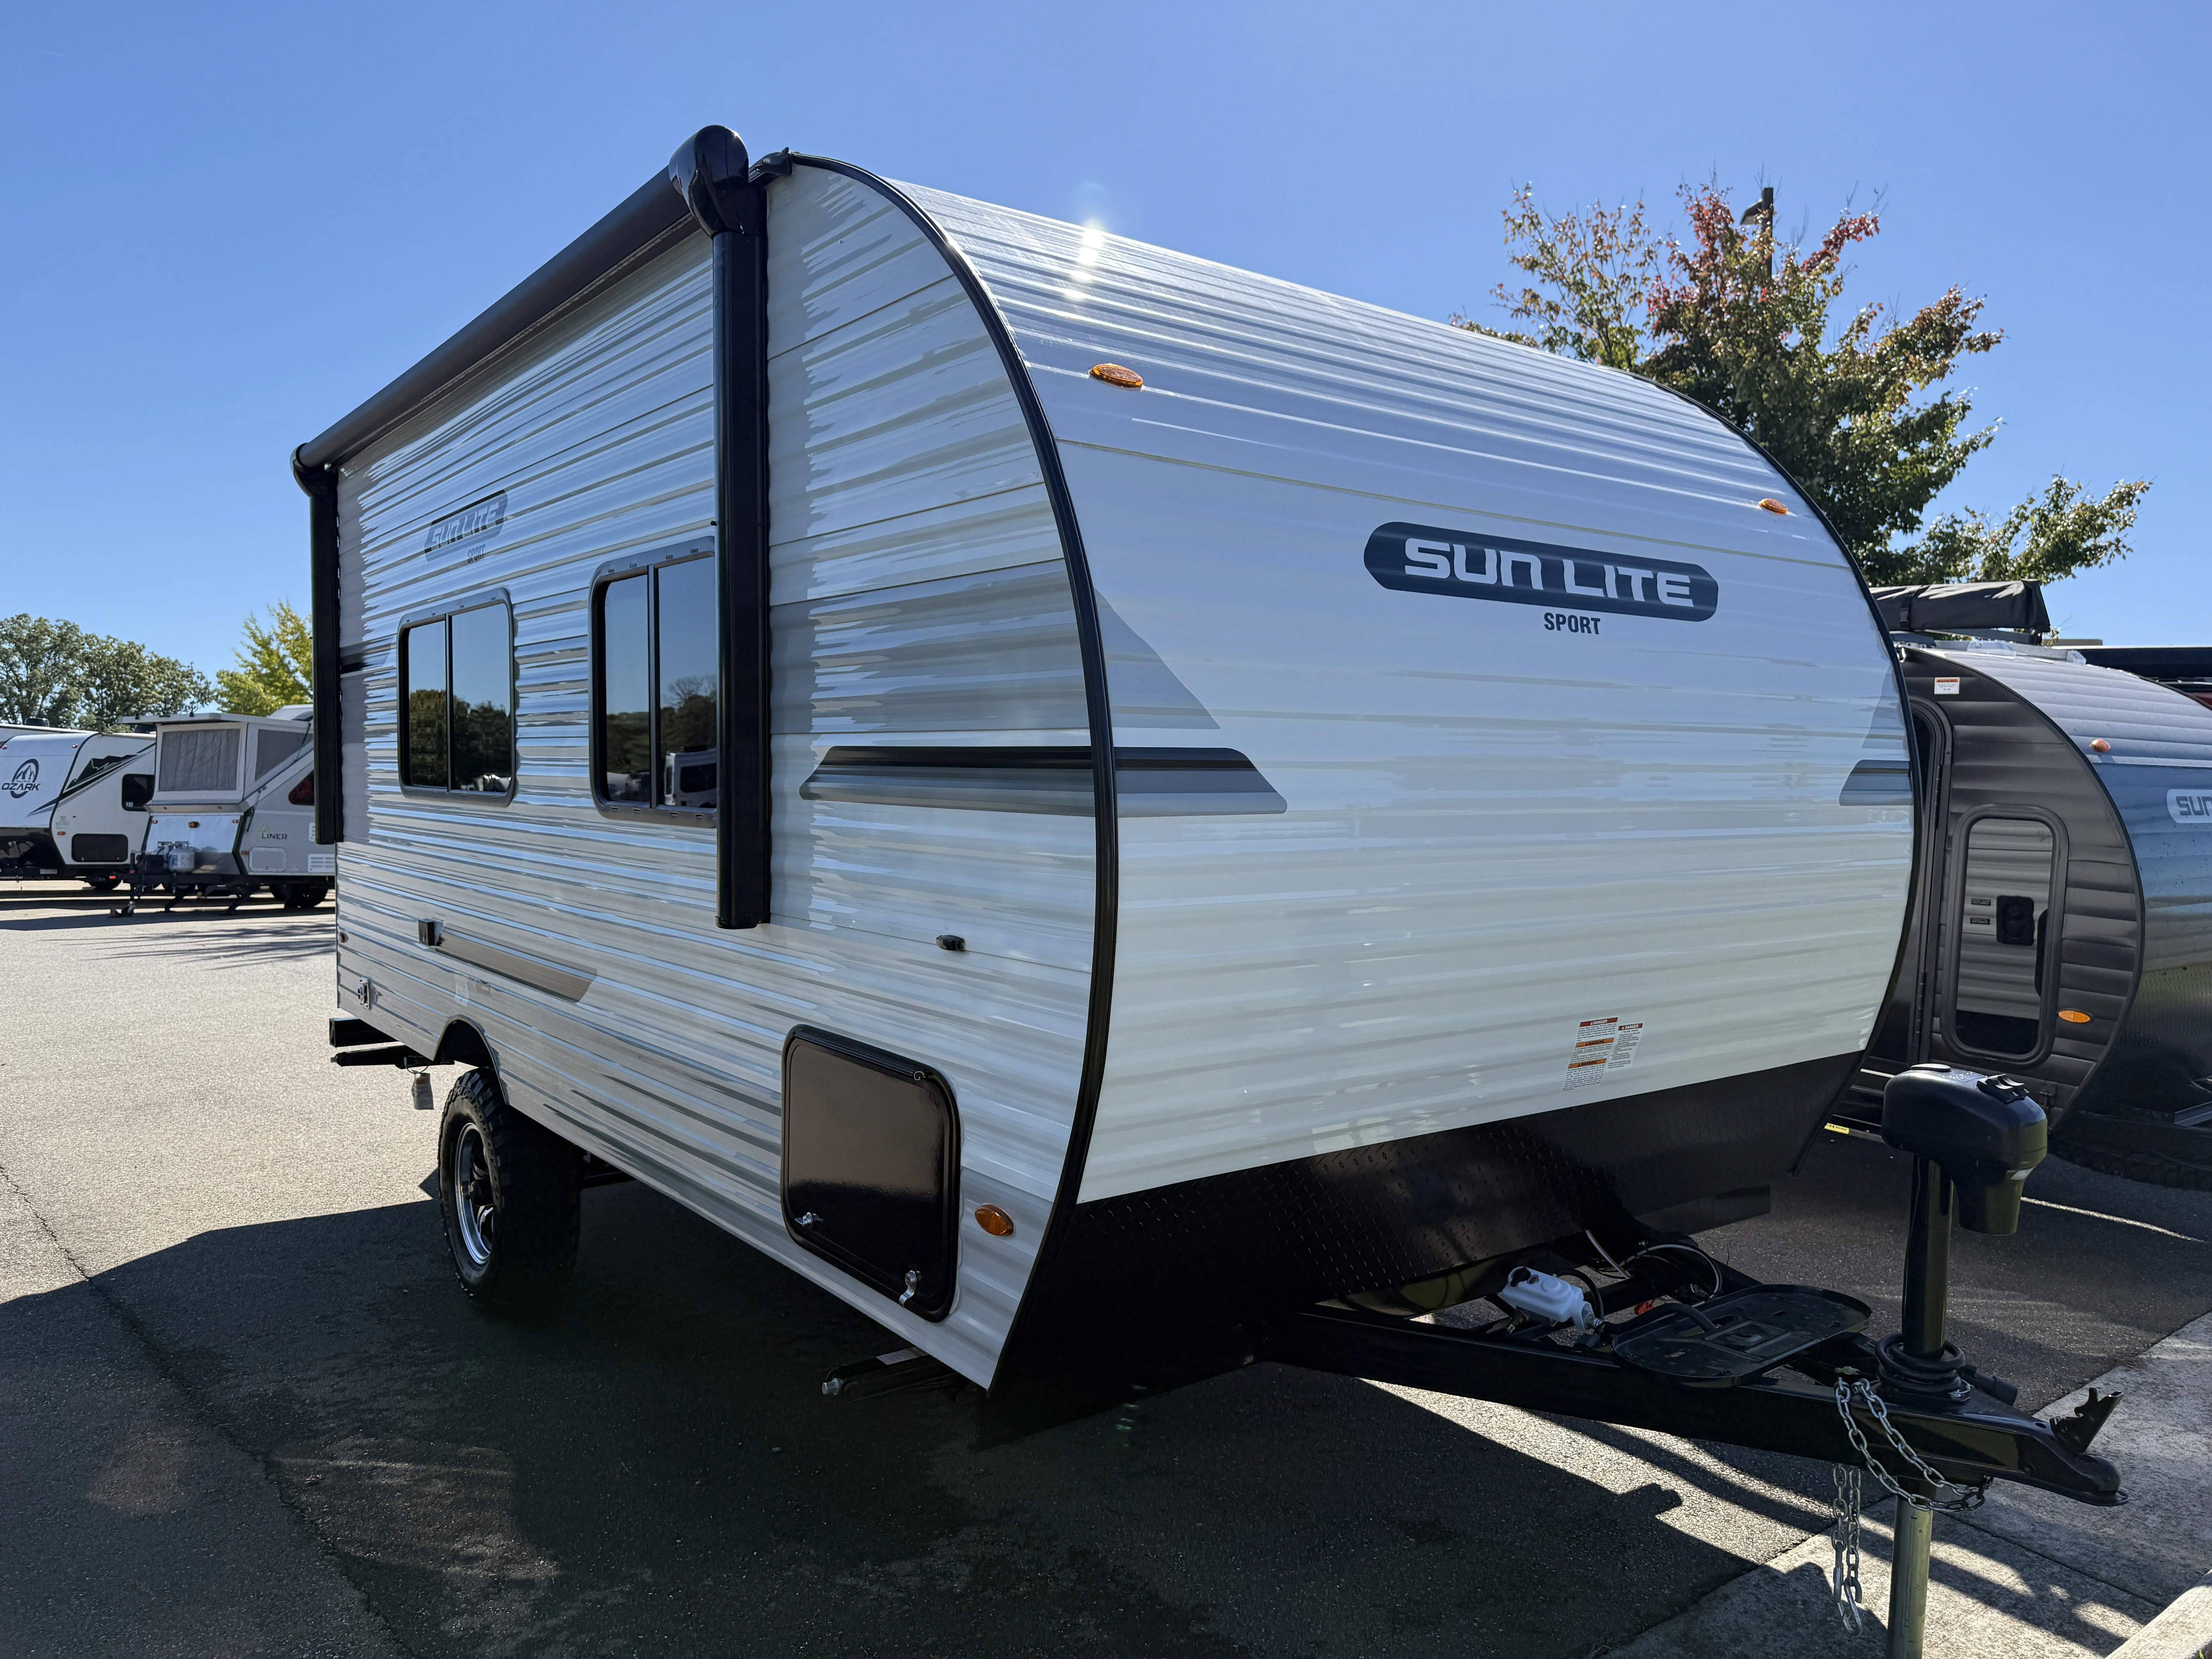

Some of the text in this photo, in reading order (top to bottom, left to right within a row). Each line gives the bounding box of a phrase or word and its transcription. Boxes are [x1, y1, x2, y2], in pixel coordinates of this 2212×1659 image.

[432, 502, 499, 548] SUN LITE
[467, 544, 485, 563] SPORT
[1405, 538, 1694, 607] SUN LITE
[1544, 612, 1600, 635] SPORT
[2, 783, 41, 791] OZARK
